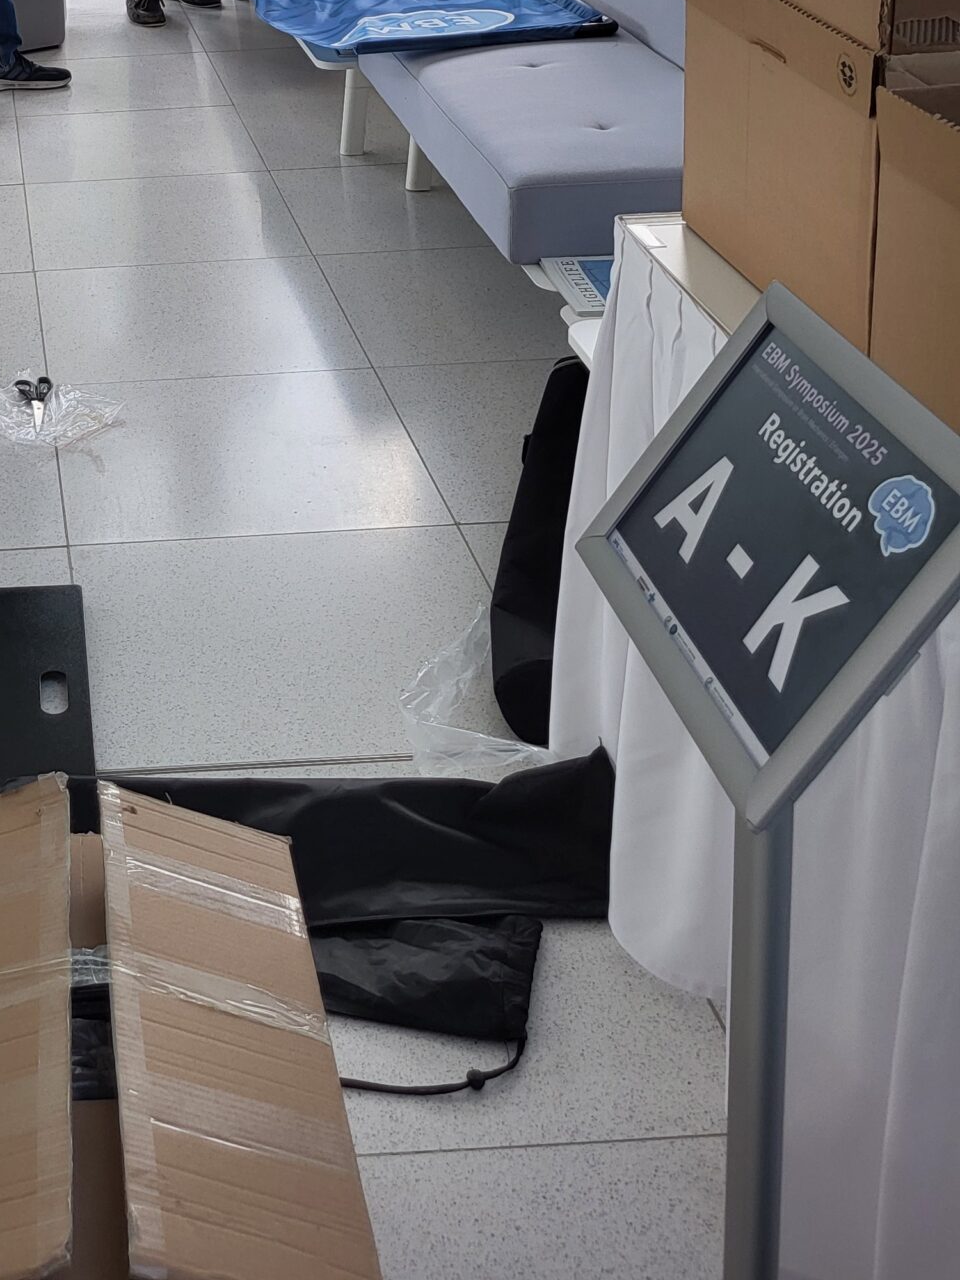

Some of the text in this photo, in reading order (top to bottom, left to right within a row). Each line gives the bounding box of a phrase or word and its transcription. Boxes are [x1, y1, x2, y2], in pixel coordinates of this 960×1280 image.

[560, 260, 606, 308] LIGHTLIFE
[761, 342, 792, 374] EBM
[785, 365, 850, 433] Symposium
[846, 424, 889, 466] 2025
[758, 412, 863, 532] Registration
[881, 489, 922, 534] EBM
[652, 455, 735, 565] A
[725, 543, 754, 580] -
[742, 553, 851, 694] K
